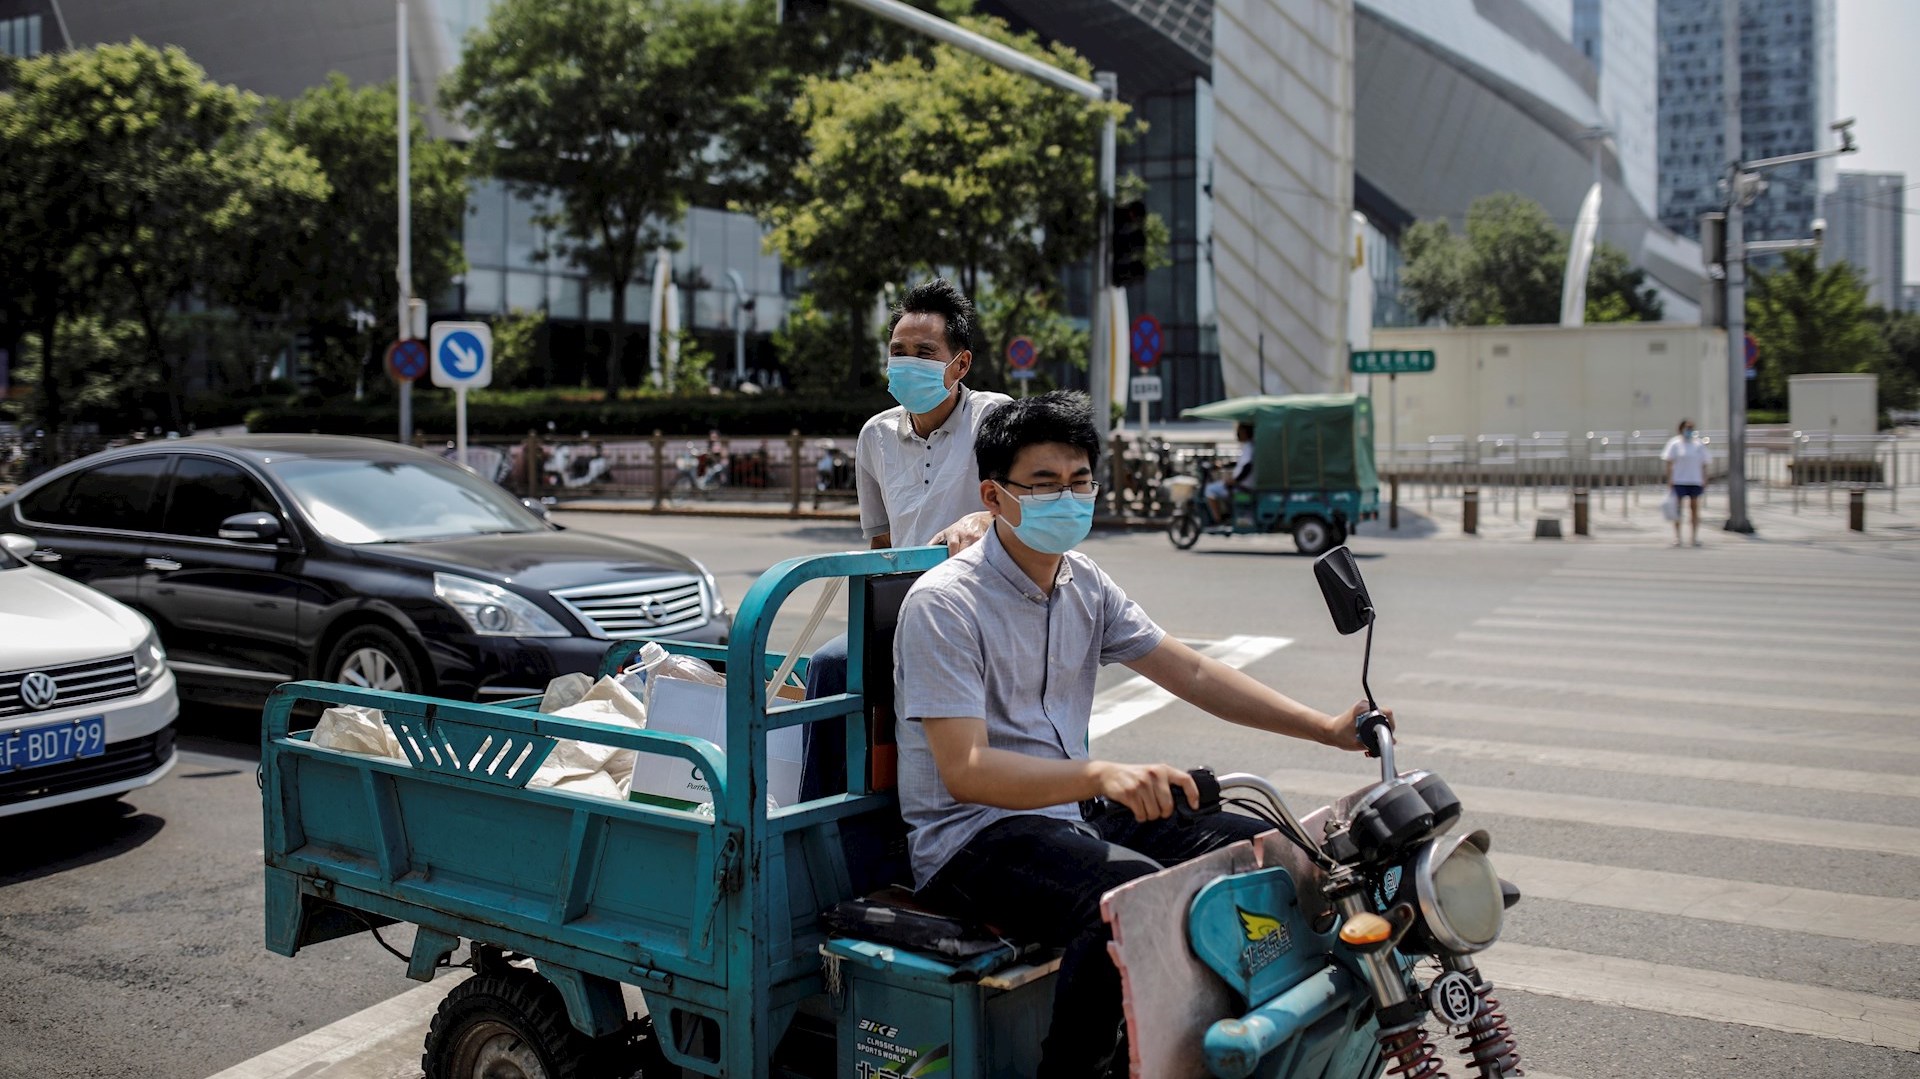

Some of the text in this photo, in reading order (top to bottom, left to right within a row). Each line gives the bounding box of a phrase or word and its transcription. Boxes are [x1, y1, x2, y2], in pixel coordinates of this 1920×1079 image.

[857, 1043, 906, 1064] SPORTS WORLD
[866, 1037, 918, 1058] CLASSIC SUPER
